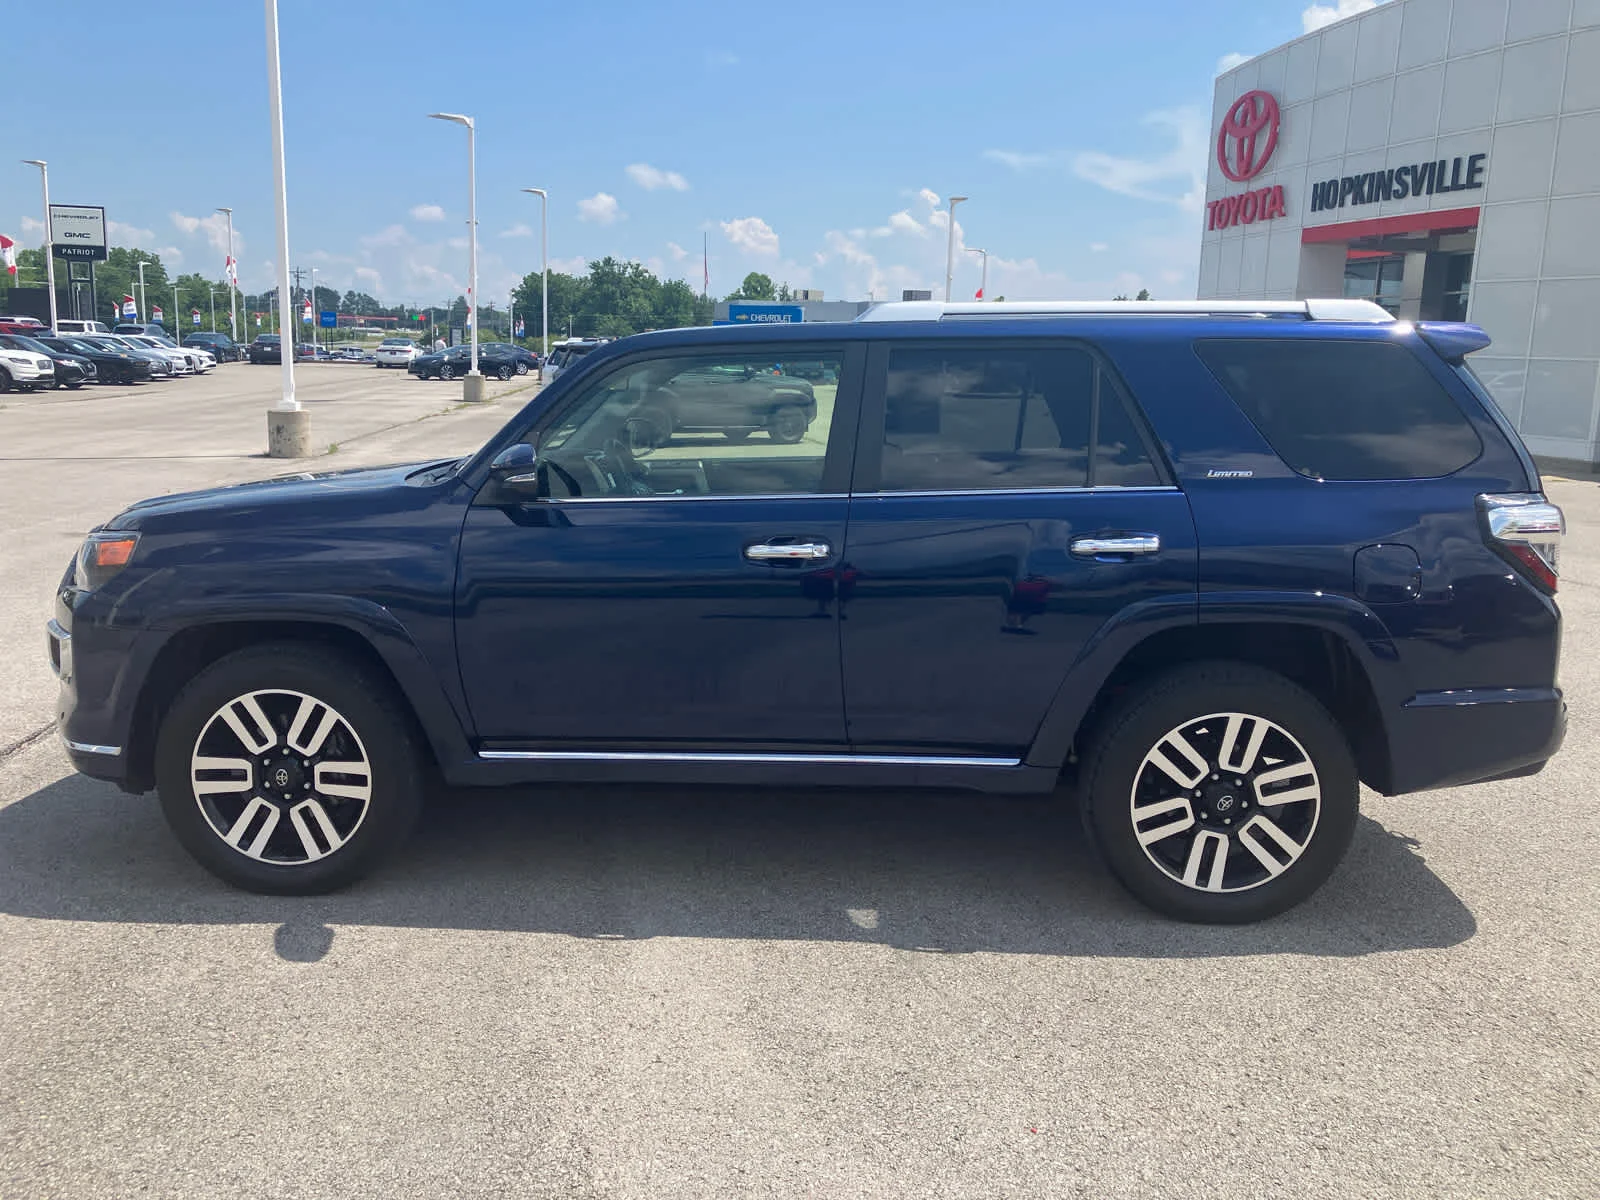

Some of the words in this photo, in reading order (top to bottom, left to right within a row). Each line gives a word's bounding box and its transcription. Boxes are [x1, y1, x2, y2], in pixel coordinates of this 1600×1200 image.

[1311, 153, 1486, 212] HOPKINSVILLE
[1207, 185, 1286, 231] TOYOTA
[62, 248, 95, 256] PATRIOT
[750, 313, 792, 323] CHEVROLET
